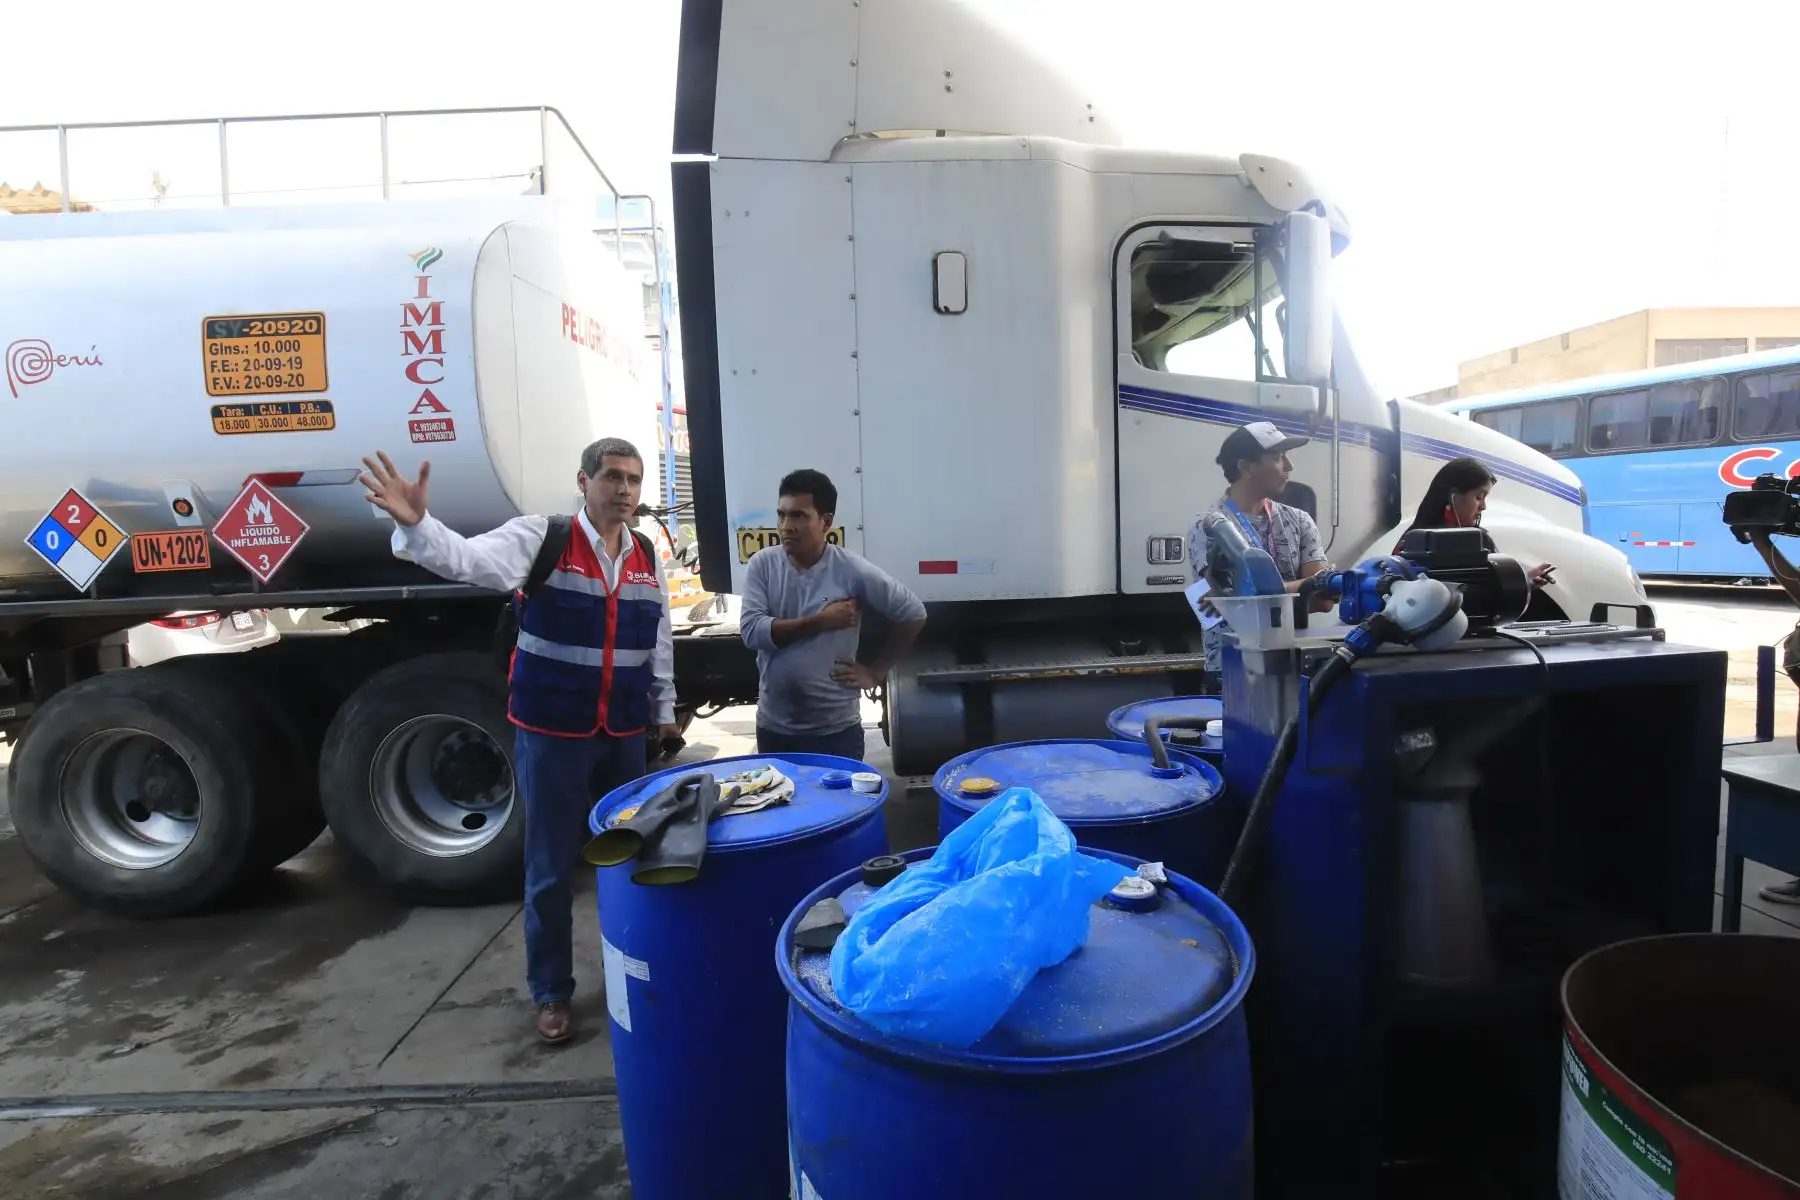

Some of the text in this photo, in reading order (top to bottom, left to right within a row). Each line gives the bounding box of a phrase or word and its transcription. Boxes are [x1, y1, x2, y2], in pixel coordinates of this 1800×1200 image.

[254, 340, 301, 353] 10.000
[400, 275, 451, 414] IMMCA
[6, 339, 103, 399] Perú
[210, 357, 303, 373] F.E.: 20-09-19
[212, 374, 305, 390] F.V.: 20-09-20
[219, 402, 320, 417] Tara: C.U.: P.B.:
[219, 419, 250, 430] 18.000
[258, 417, 289, 429] 30.000
[67, 504, 81, 524] 2
[46, 528, 108, 550] 0 0
[239, 526, 281, 538] LIQUIDO
[230, 535, 292, 548] INFLAMABLE
[137, 535, 206, 568] UN-1202
[258, 554, 271, 571] 3
